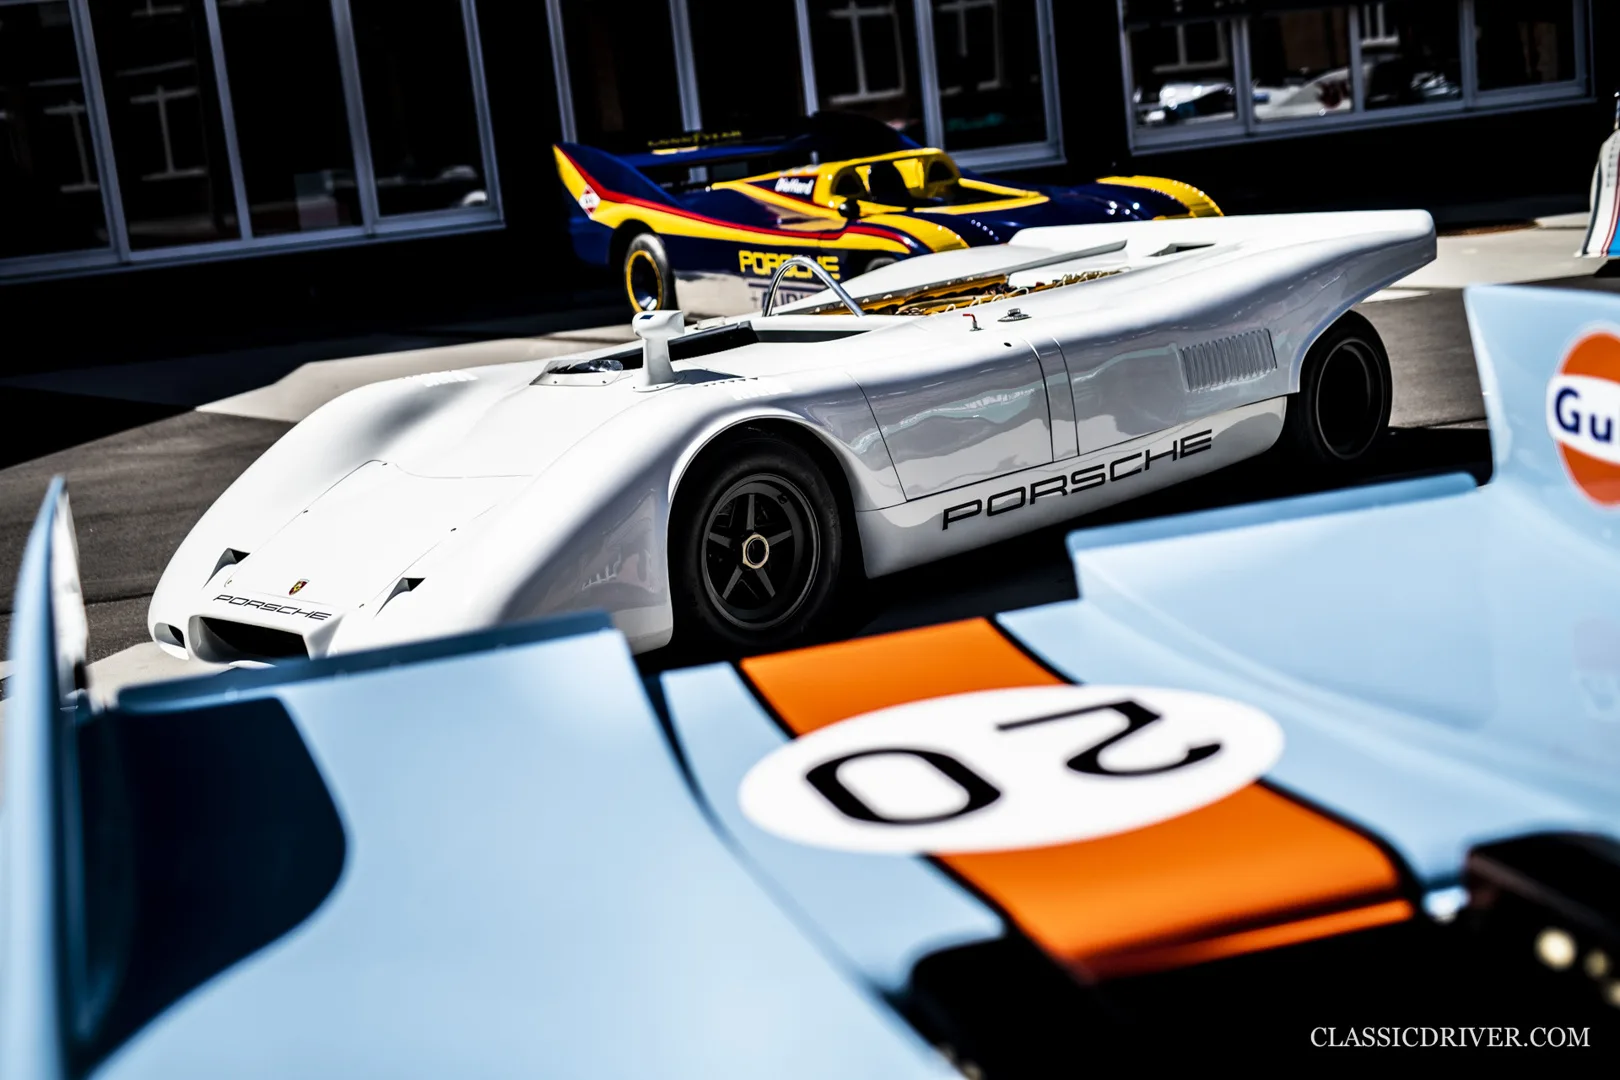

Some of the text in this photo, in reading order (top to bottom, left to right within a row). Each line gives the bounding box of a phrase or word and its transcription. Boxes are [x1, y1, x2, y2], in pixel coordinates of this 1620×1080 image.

[942, 428, 1213, 531] PORSCHE
[213, 594, 332, 620] PORSCHE
[804, 699, 1222, 826] 20
